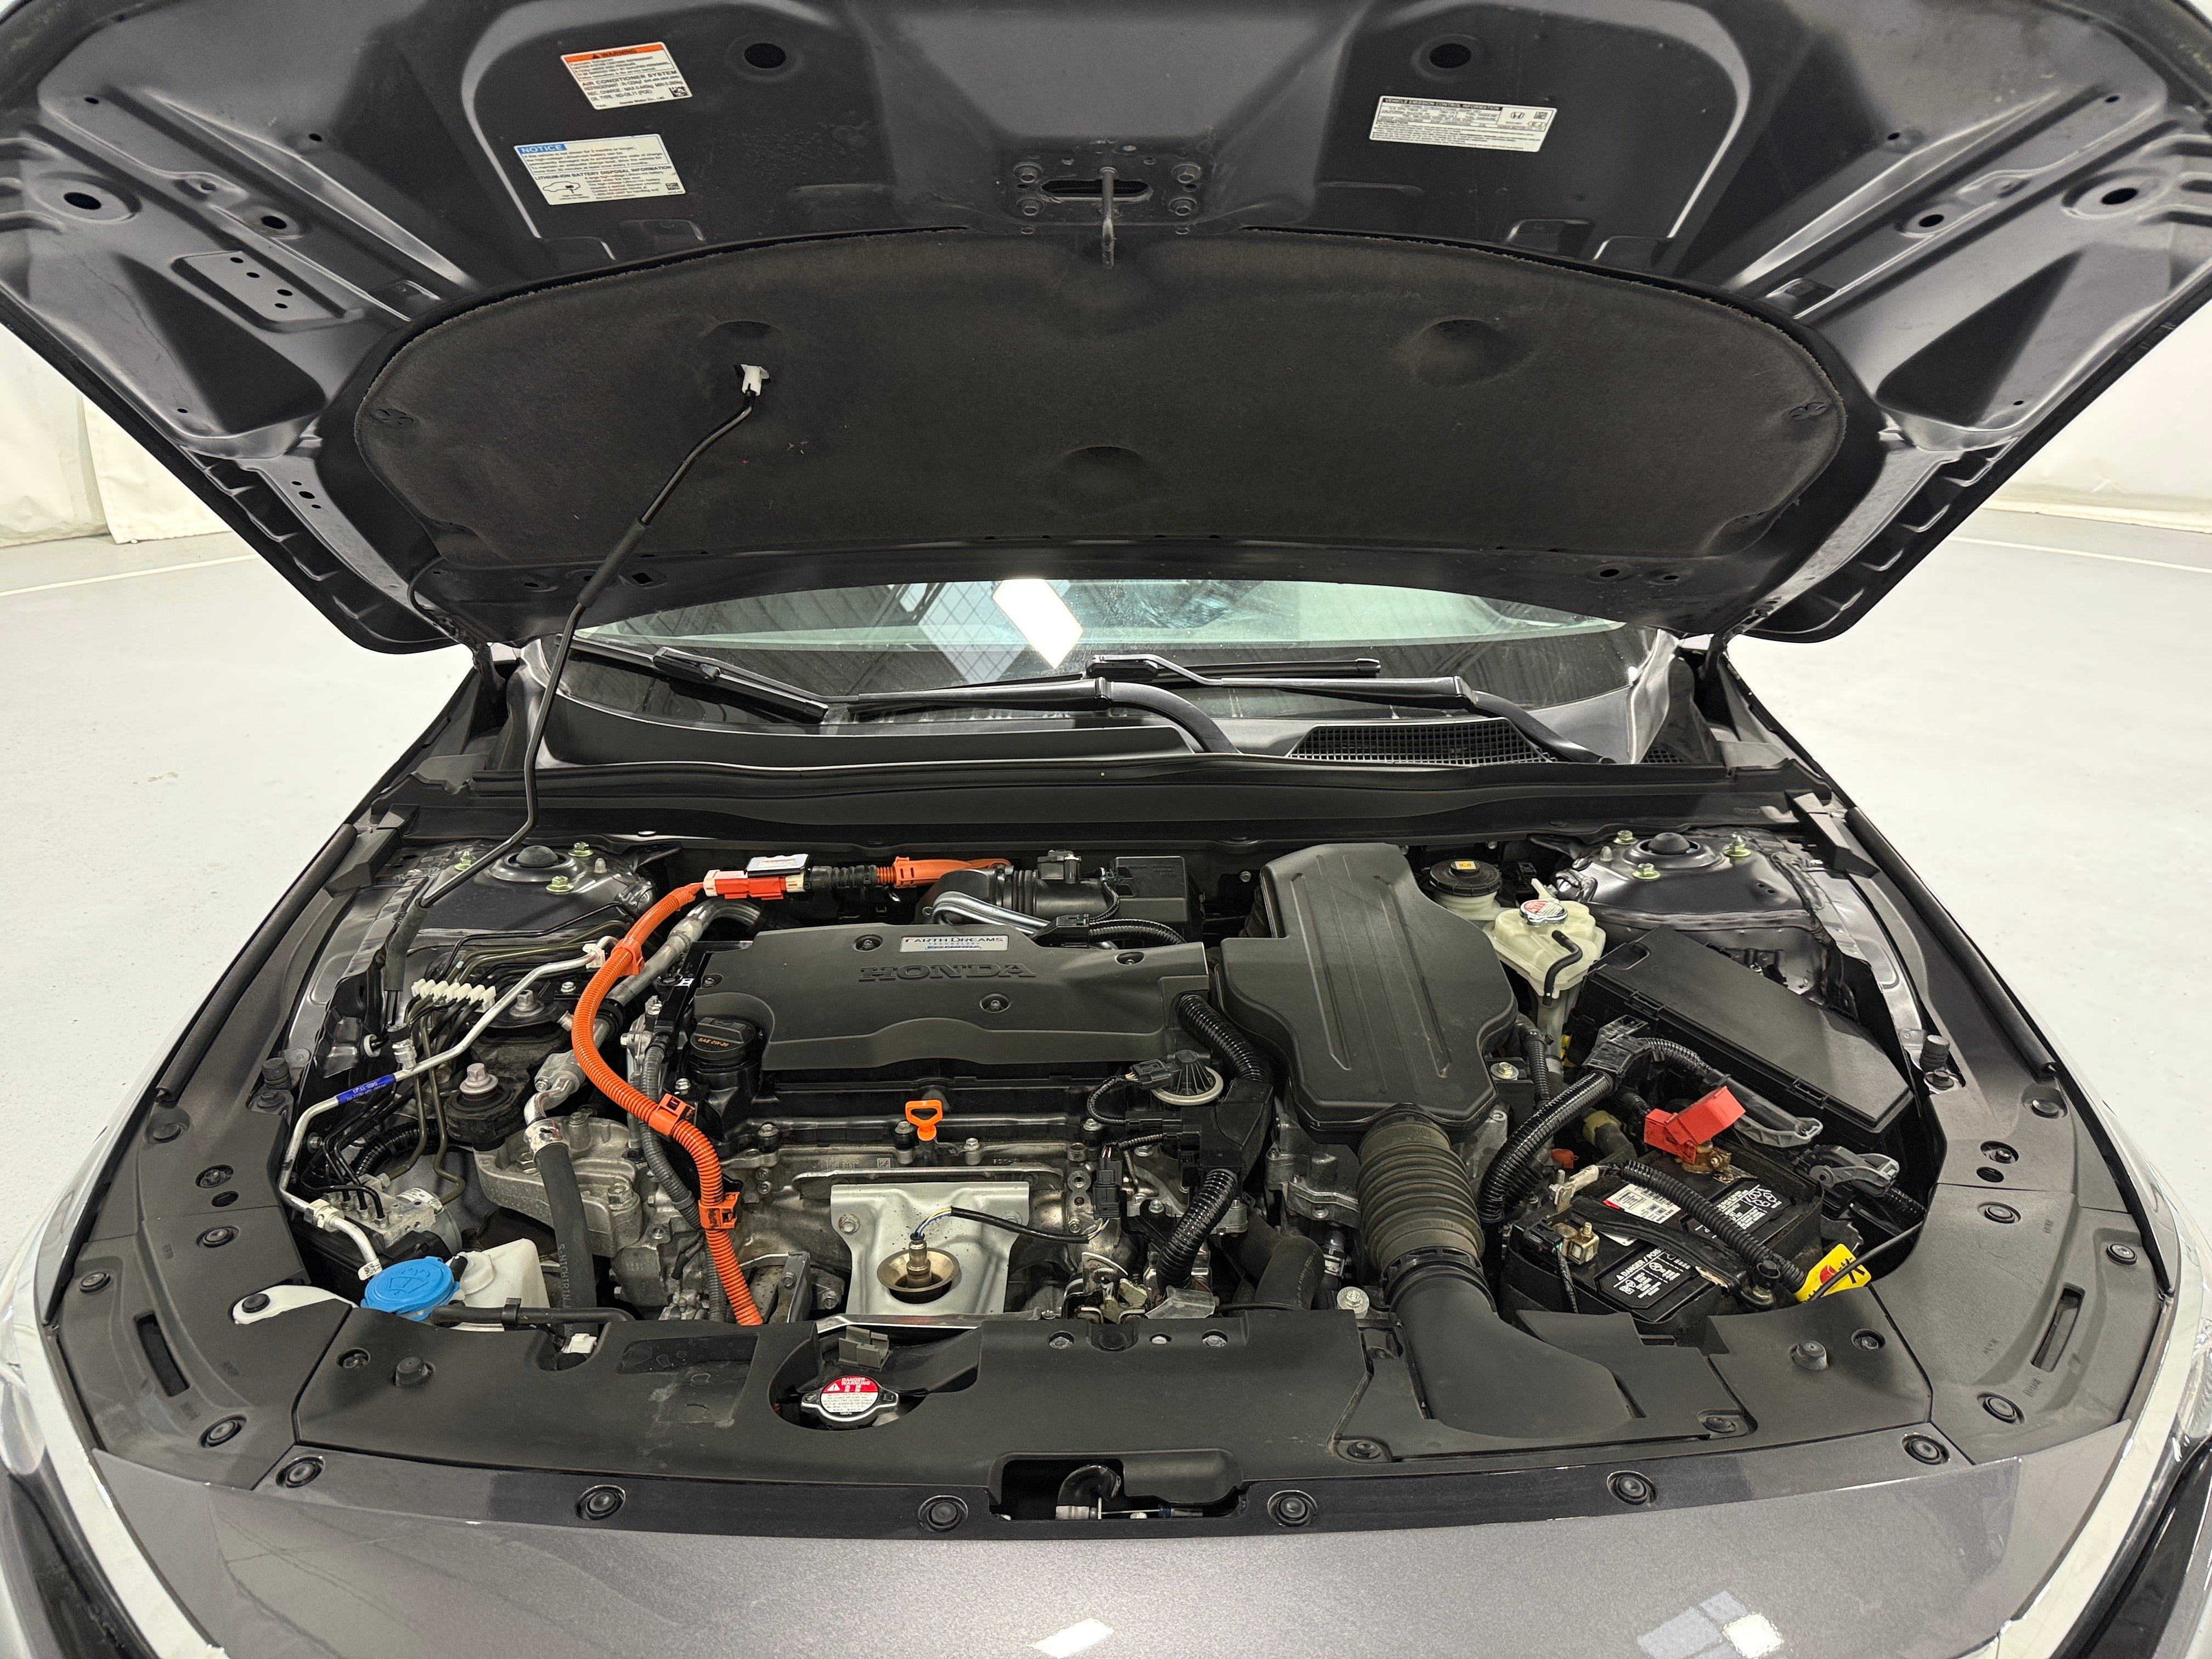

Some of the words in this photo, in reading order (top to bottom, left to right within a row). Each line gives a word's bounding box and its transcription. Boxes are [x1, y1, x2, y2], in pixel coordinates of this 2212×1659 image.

[595, 74, 646, 84] CONDITIONER
[858, 963, 1036, 981] HONDA
[557, 1244, 571, 1300] S-NICHIRIN
[1622, 1260, 1645, 1277] DANGER
